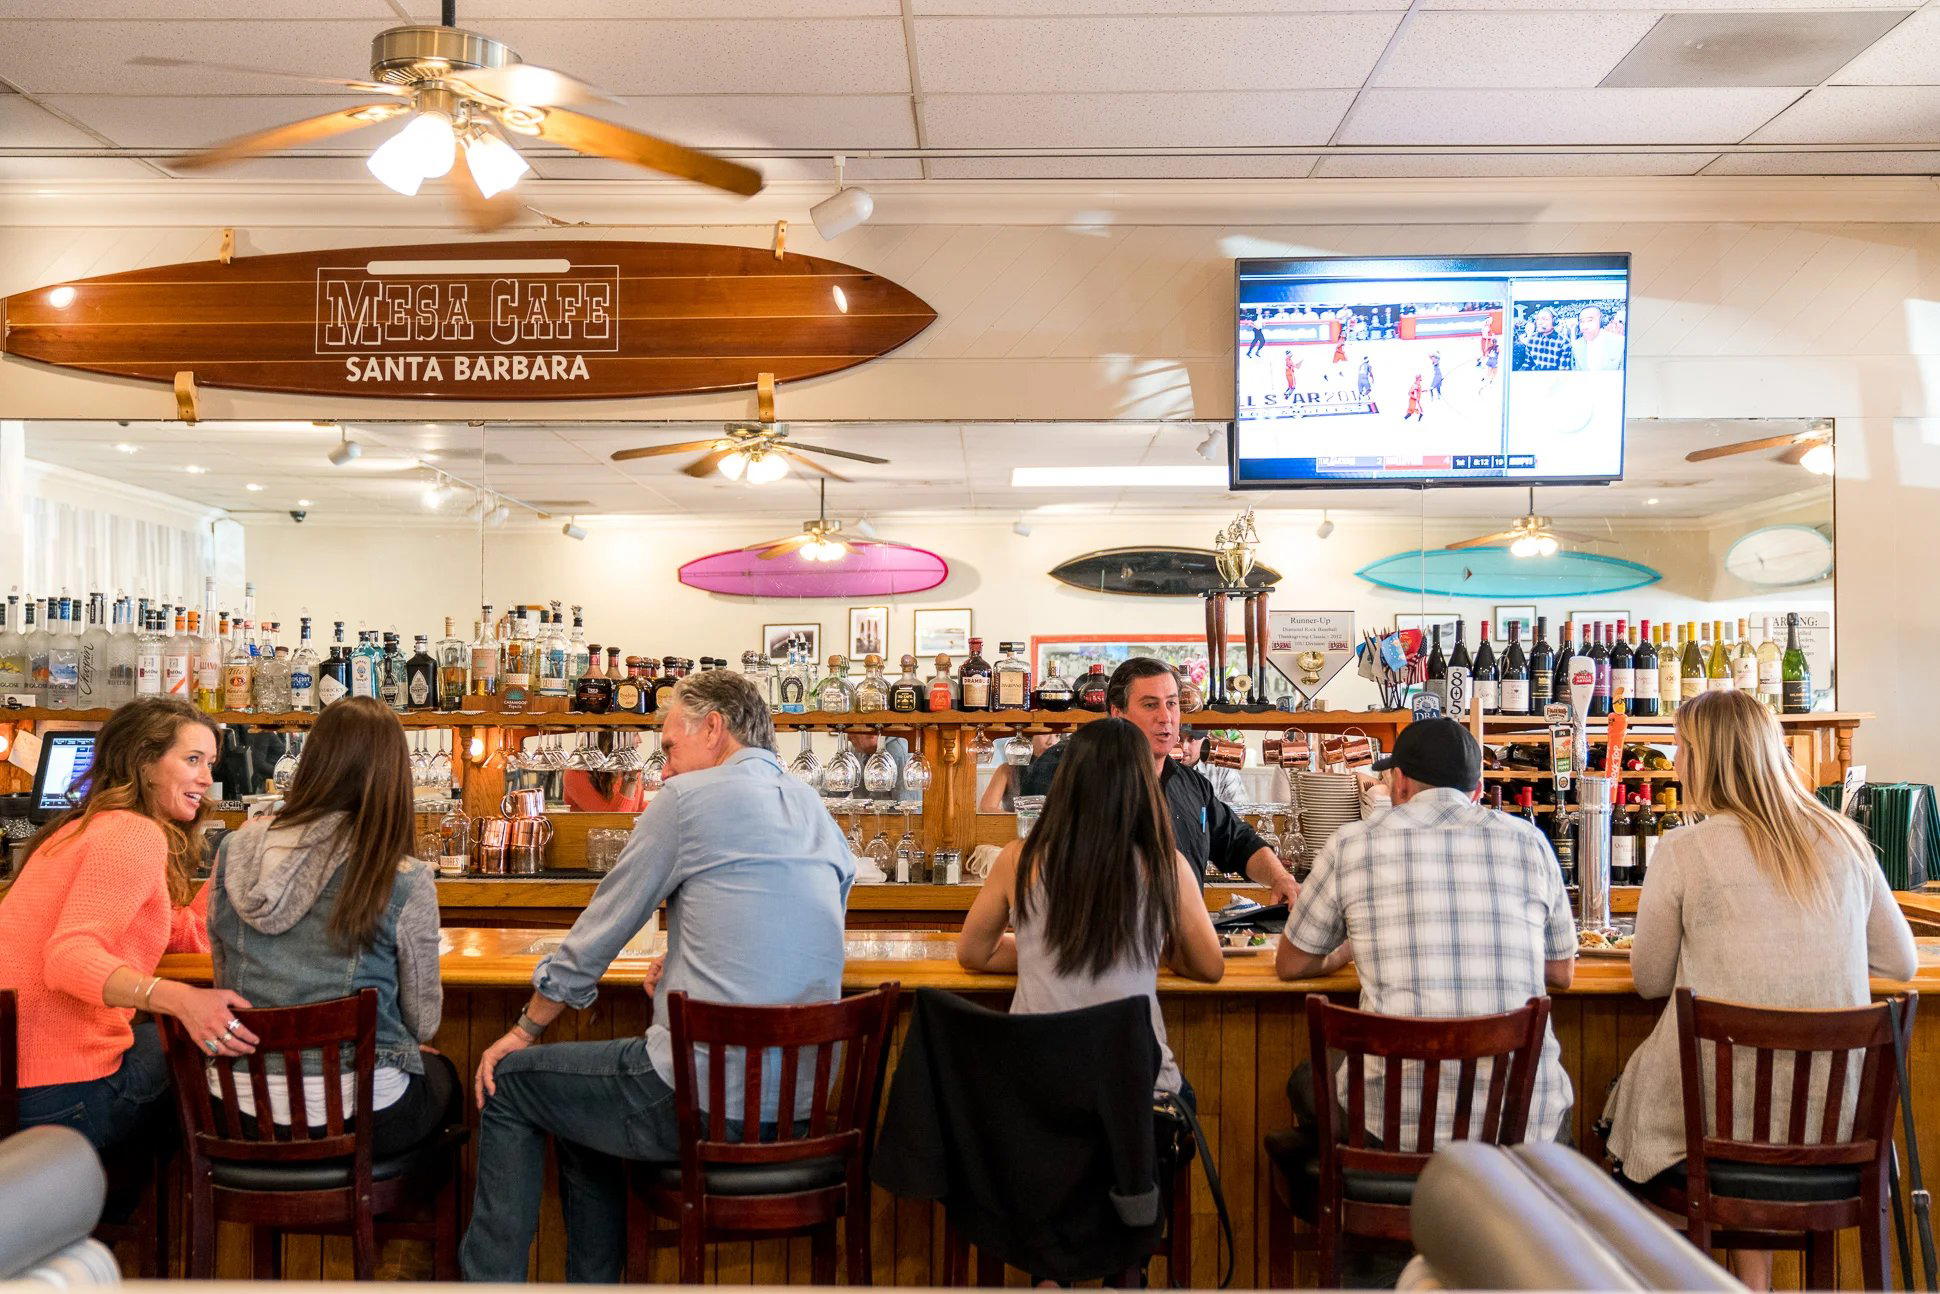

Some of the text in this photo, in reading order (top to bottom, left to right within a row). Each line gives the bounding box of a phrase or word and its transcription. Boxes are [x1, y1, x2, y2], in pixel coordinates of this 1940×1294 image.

[326, 279, 610, 346] MESA CAFE
[345, 354, 590, 383] SANTA BARBARA
[1290, 617, 1331, 625] Runner-Up
